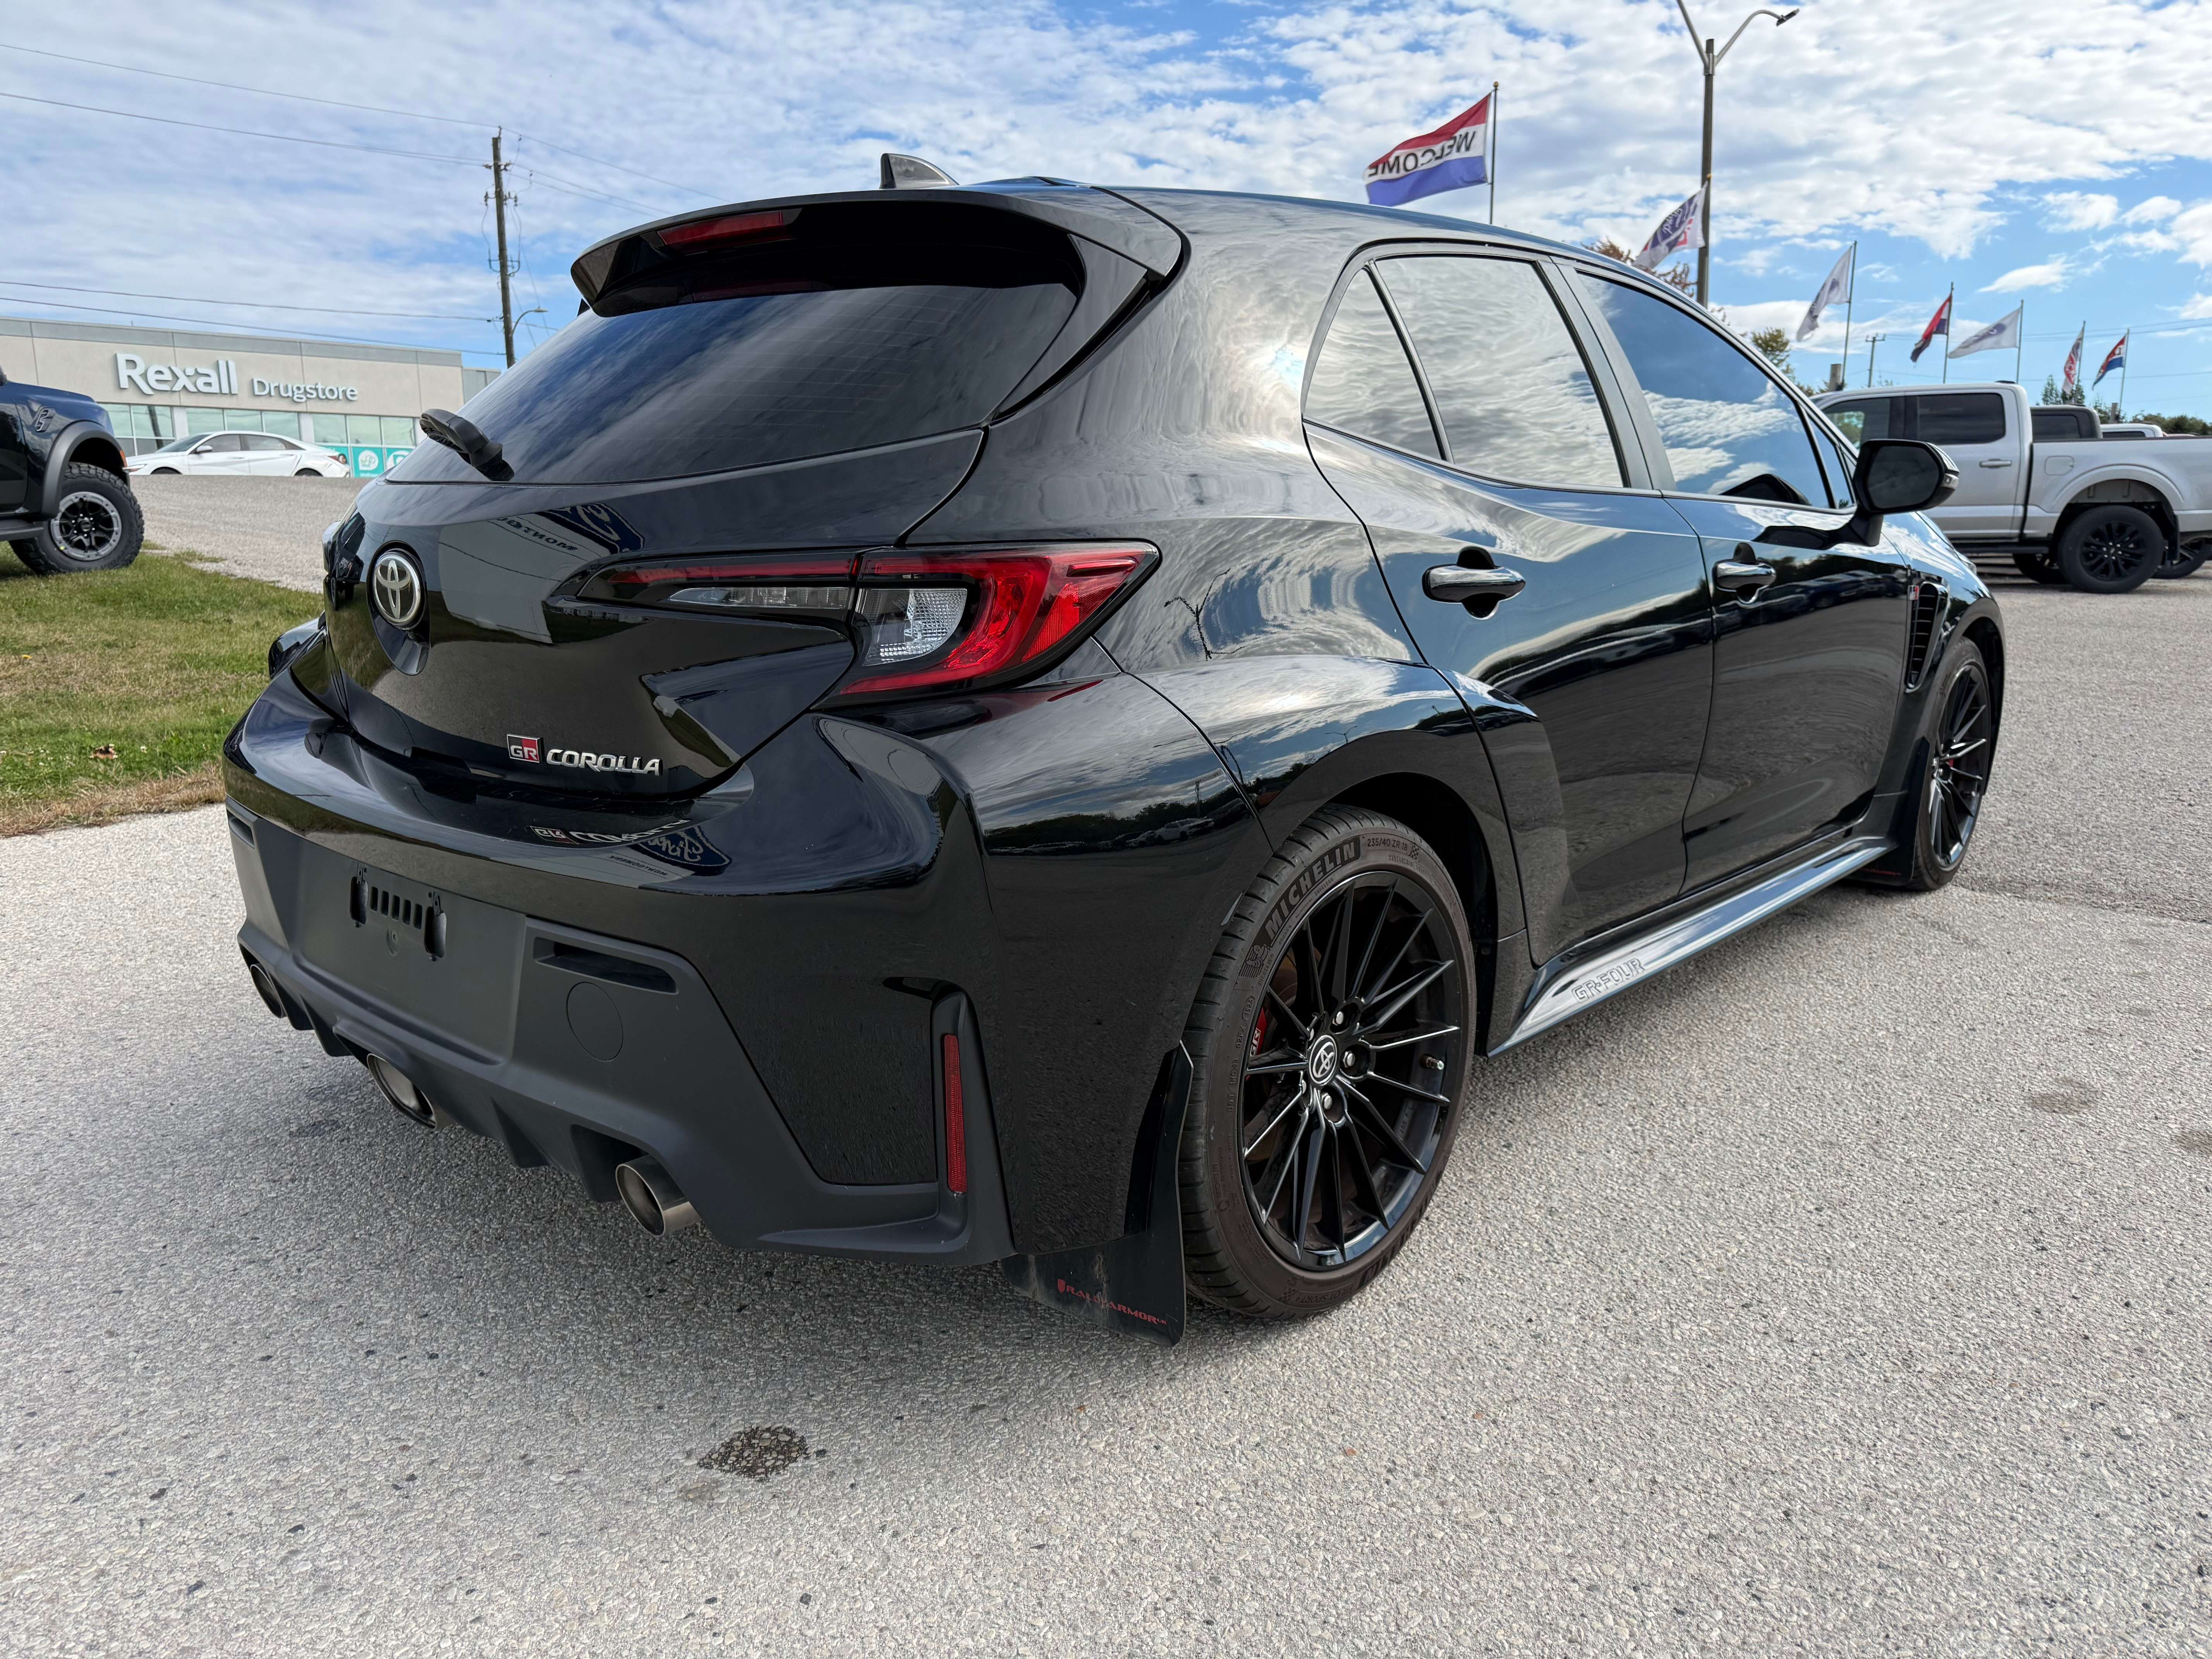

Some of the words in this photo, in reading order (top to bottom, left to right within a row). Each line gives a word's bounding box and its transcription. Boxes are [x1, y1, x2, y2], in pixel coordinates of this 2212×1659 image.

[115, 353, 238, 395] Rexall
[252, 378, 358, 404] Drugstore
[510, 745, 538, 761] GR
[547, 749, 661, 776] COROLLA
[1367, 838, 1390, 847] 235/40
[1392, 840, 1400, 849] ZR
[1402, 842, 1408, 851] 18
[1265, 842, 1355, 940] MICHELIN
